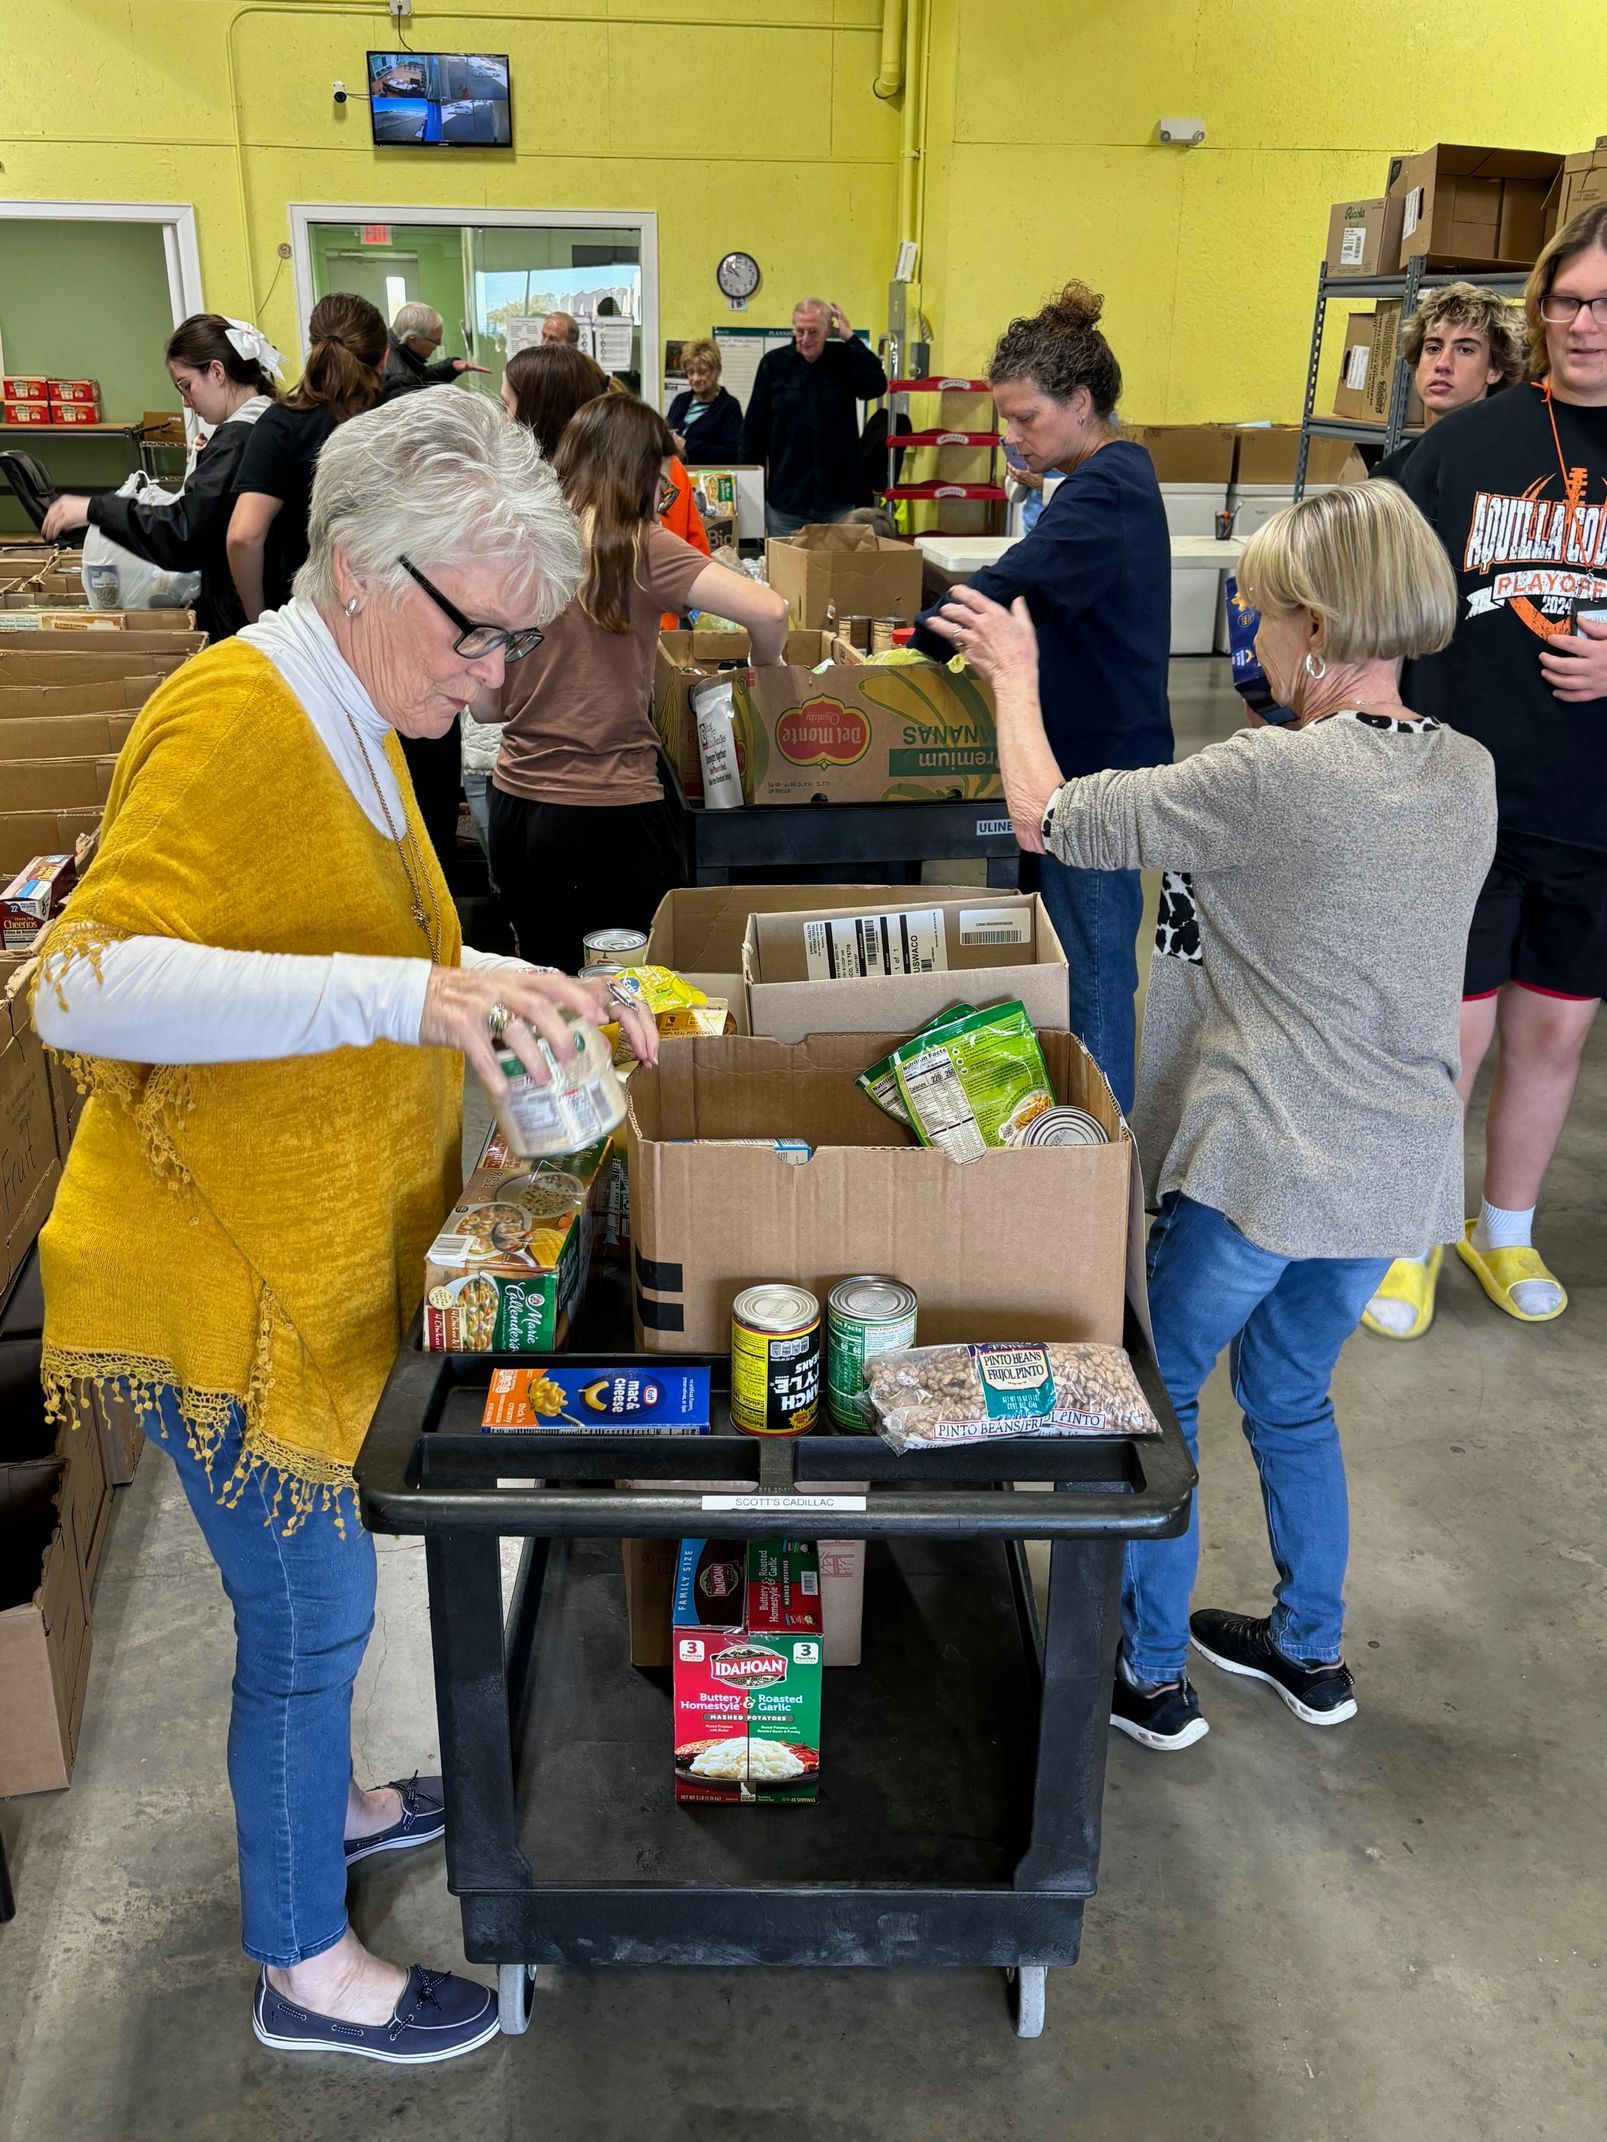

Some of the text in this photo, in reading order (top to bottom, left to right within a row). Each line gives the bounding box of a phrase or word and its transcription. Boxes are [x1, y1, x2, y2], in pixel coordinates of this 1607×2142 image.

[1464, 491, 1565, 574] AQUILLA
[1541, 596, 1572, 616] 2024
[806, 711, 840, 726] Quality
[782, 726, 862, 745] Del Monte
[902, 725, 997, 746] ANANAS
[978, 820, 1013, 833] ULINE
[10, 905, 18, 913] 22
[3, 920, 38, 930] Cheerios
[894, 956, 900, 964] of
[910, 934, 921, 974] USWACO
[908, 1081, 927, 1094] Calories
[504, 1281, 526, 1353] Callender's
[521, 1296, 543, 1345] Marie
[433, 1320, 443, 1346] Chicken
[450, 1315, 459, 1339] Chicken
[844, 1322, 862, 1332] Facts
[795, 1354, 819, 1374] EANS
[984, 1351, 1042, 1367] PINTO BEANS
[987, 1364, 1044, 1382] FRIJOL PINTO
[781, 1383, 819, 1411] ANCH
[505, 1402, 514, 1424] creamy
[517, 1402, 527, 1418] thick
[938, 1424, 977, 1437] PINTO
[1060, 1412, 1101, 1426] PINTO
[735, 1497, 834, 1507] SCOTT'S CADILLAC
[758, 1550, 768, 1577] Roasted
[678, 1550, 693, 1611] FAMILY SIZE
[714, 1564, 727, 1595] IDAHOAN
[759, 1585, 769, 1611] Buttery
[769, 1556, 779, 1623] Homestyle Garlic
[686, 1641, 698, 1654] 3
[800, 1644, 812, 1656] 3
[715, 1660, 783, 1676] IDAHOAN
[680, 1700, 792, 1712] Homestyle Garlic
[699, 1692, 804, 1710] Buttery & Roasted
